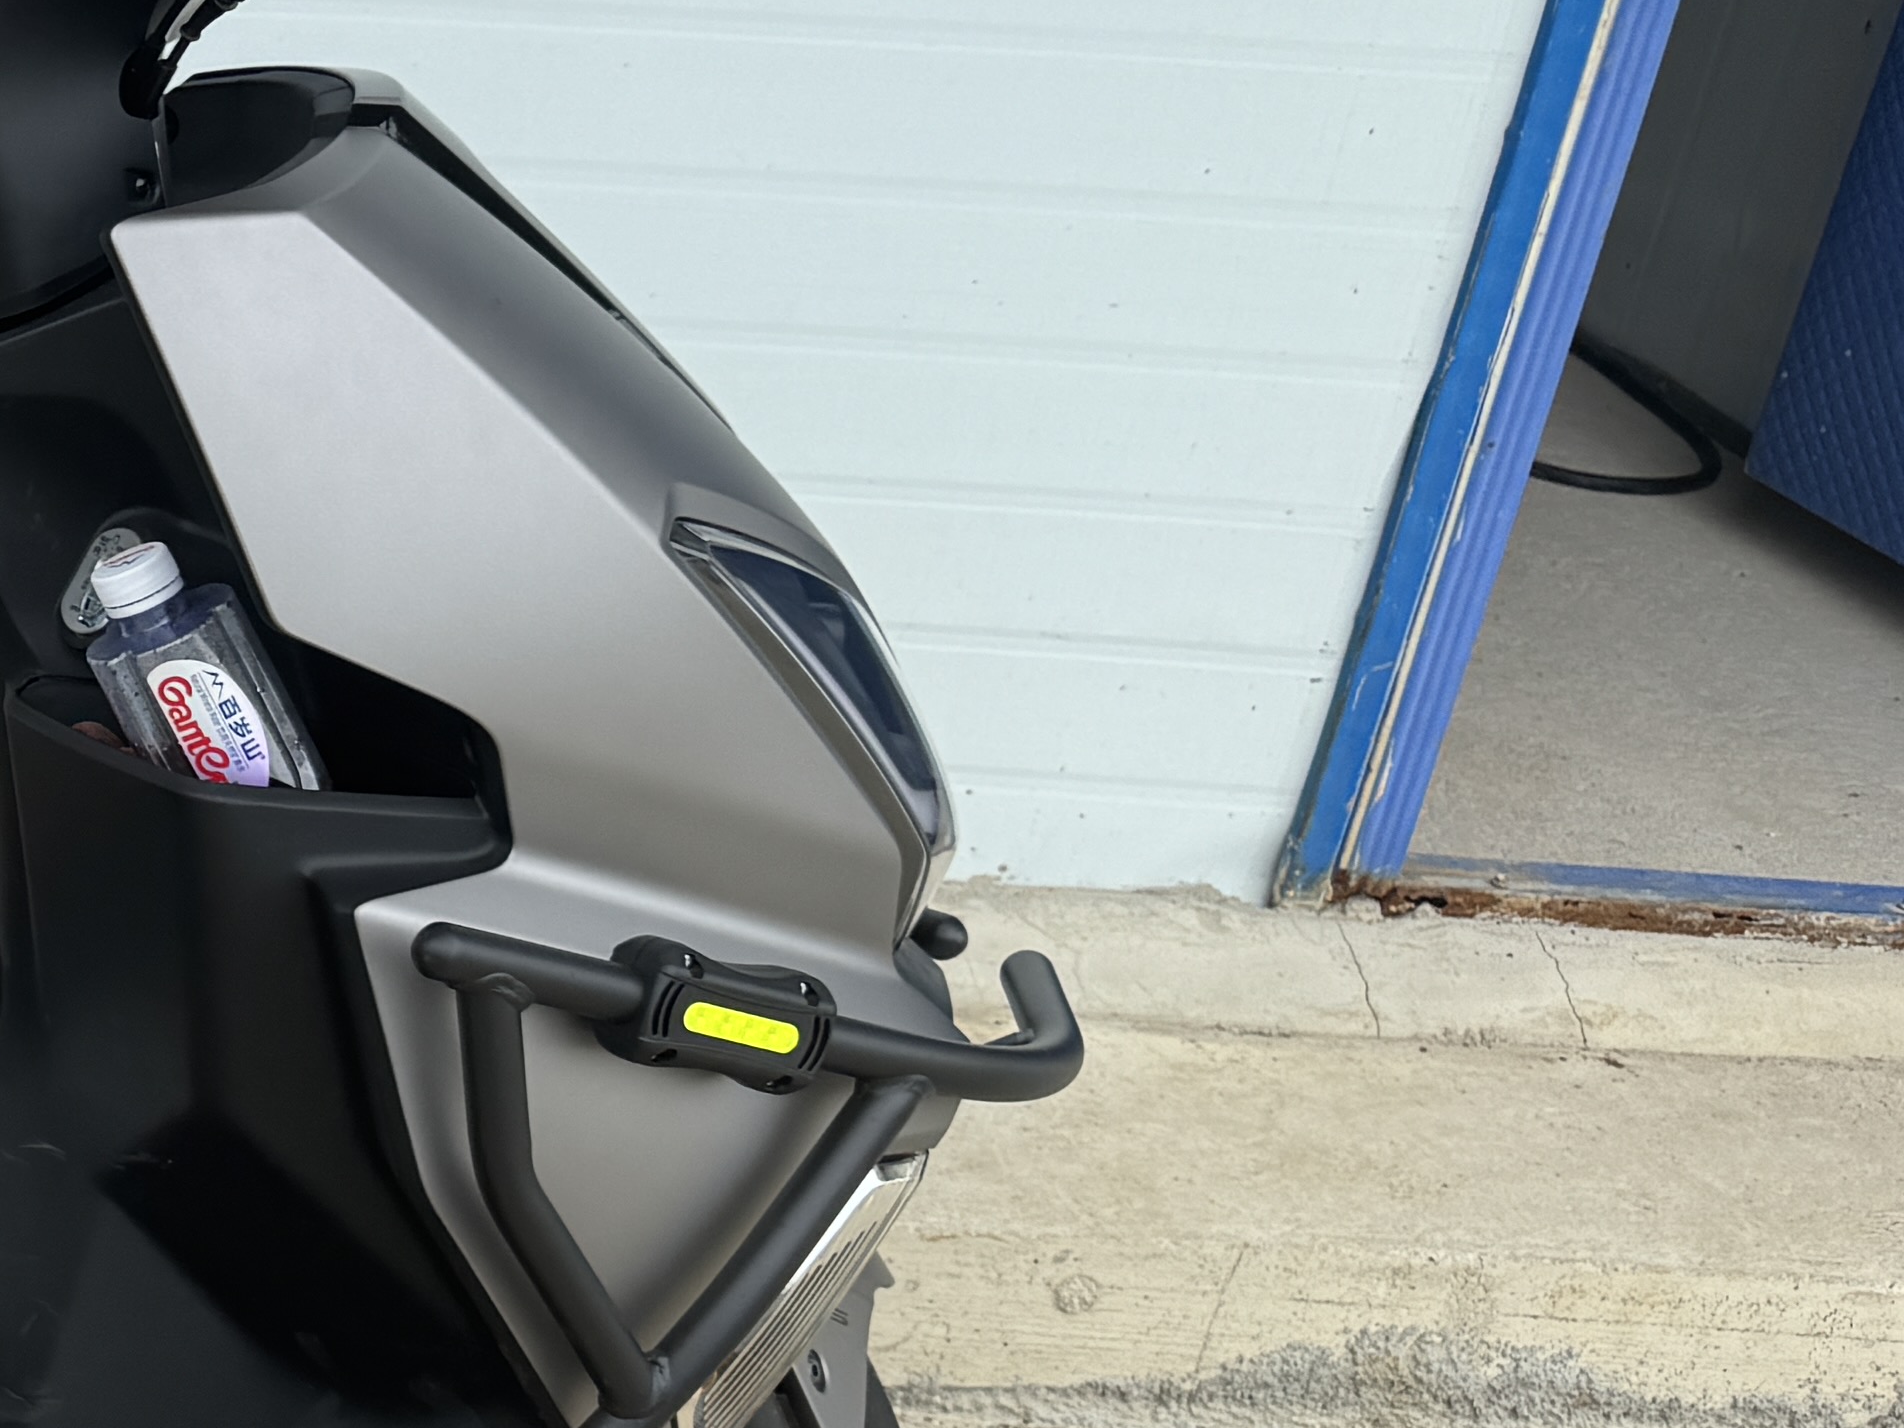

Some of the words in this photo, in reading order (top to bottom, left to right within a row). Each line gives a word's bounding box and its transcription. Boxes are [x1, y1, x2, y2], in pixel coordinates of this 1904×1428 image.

[158, 676, 230, 783] Gante
[218, 695, 263, 761] 百岁山
